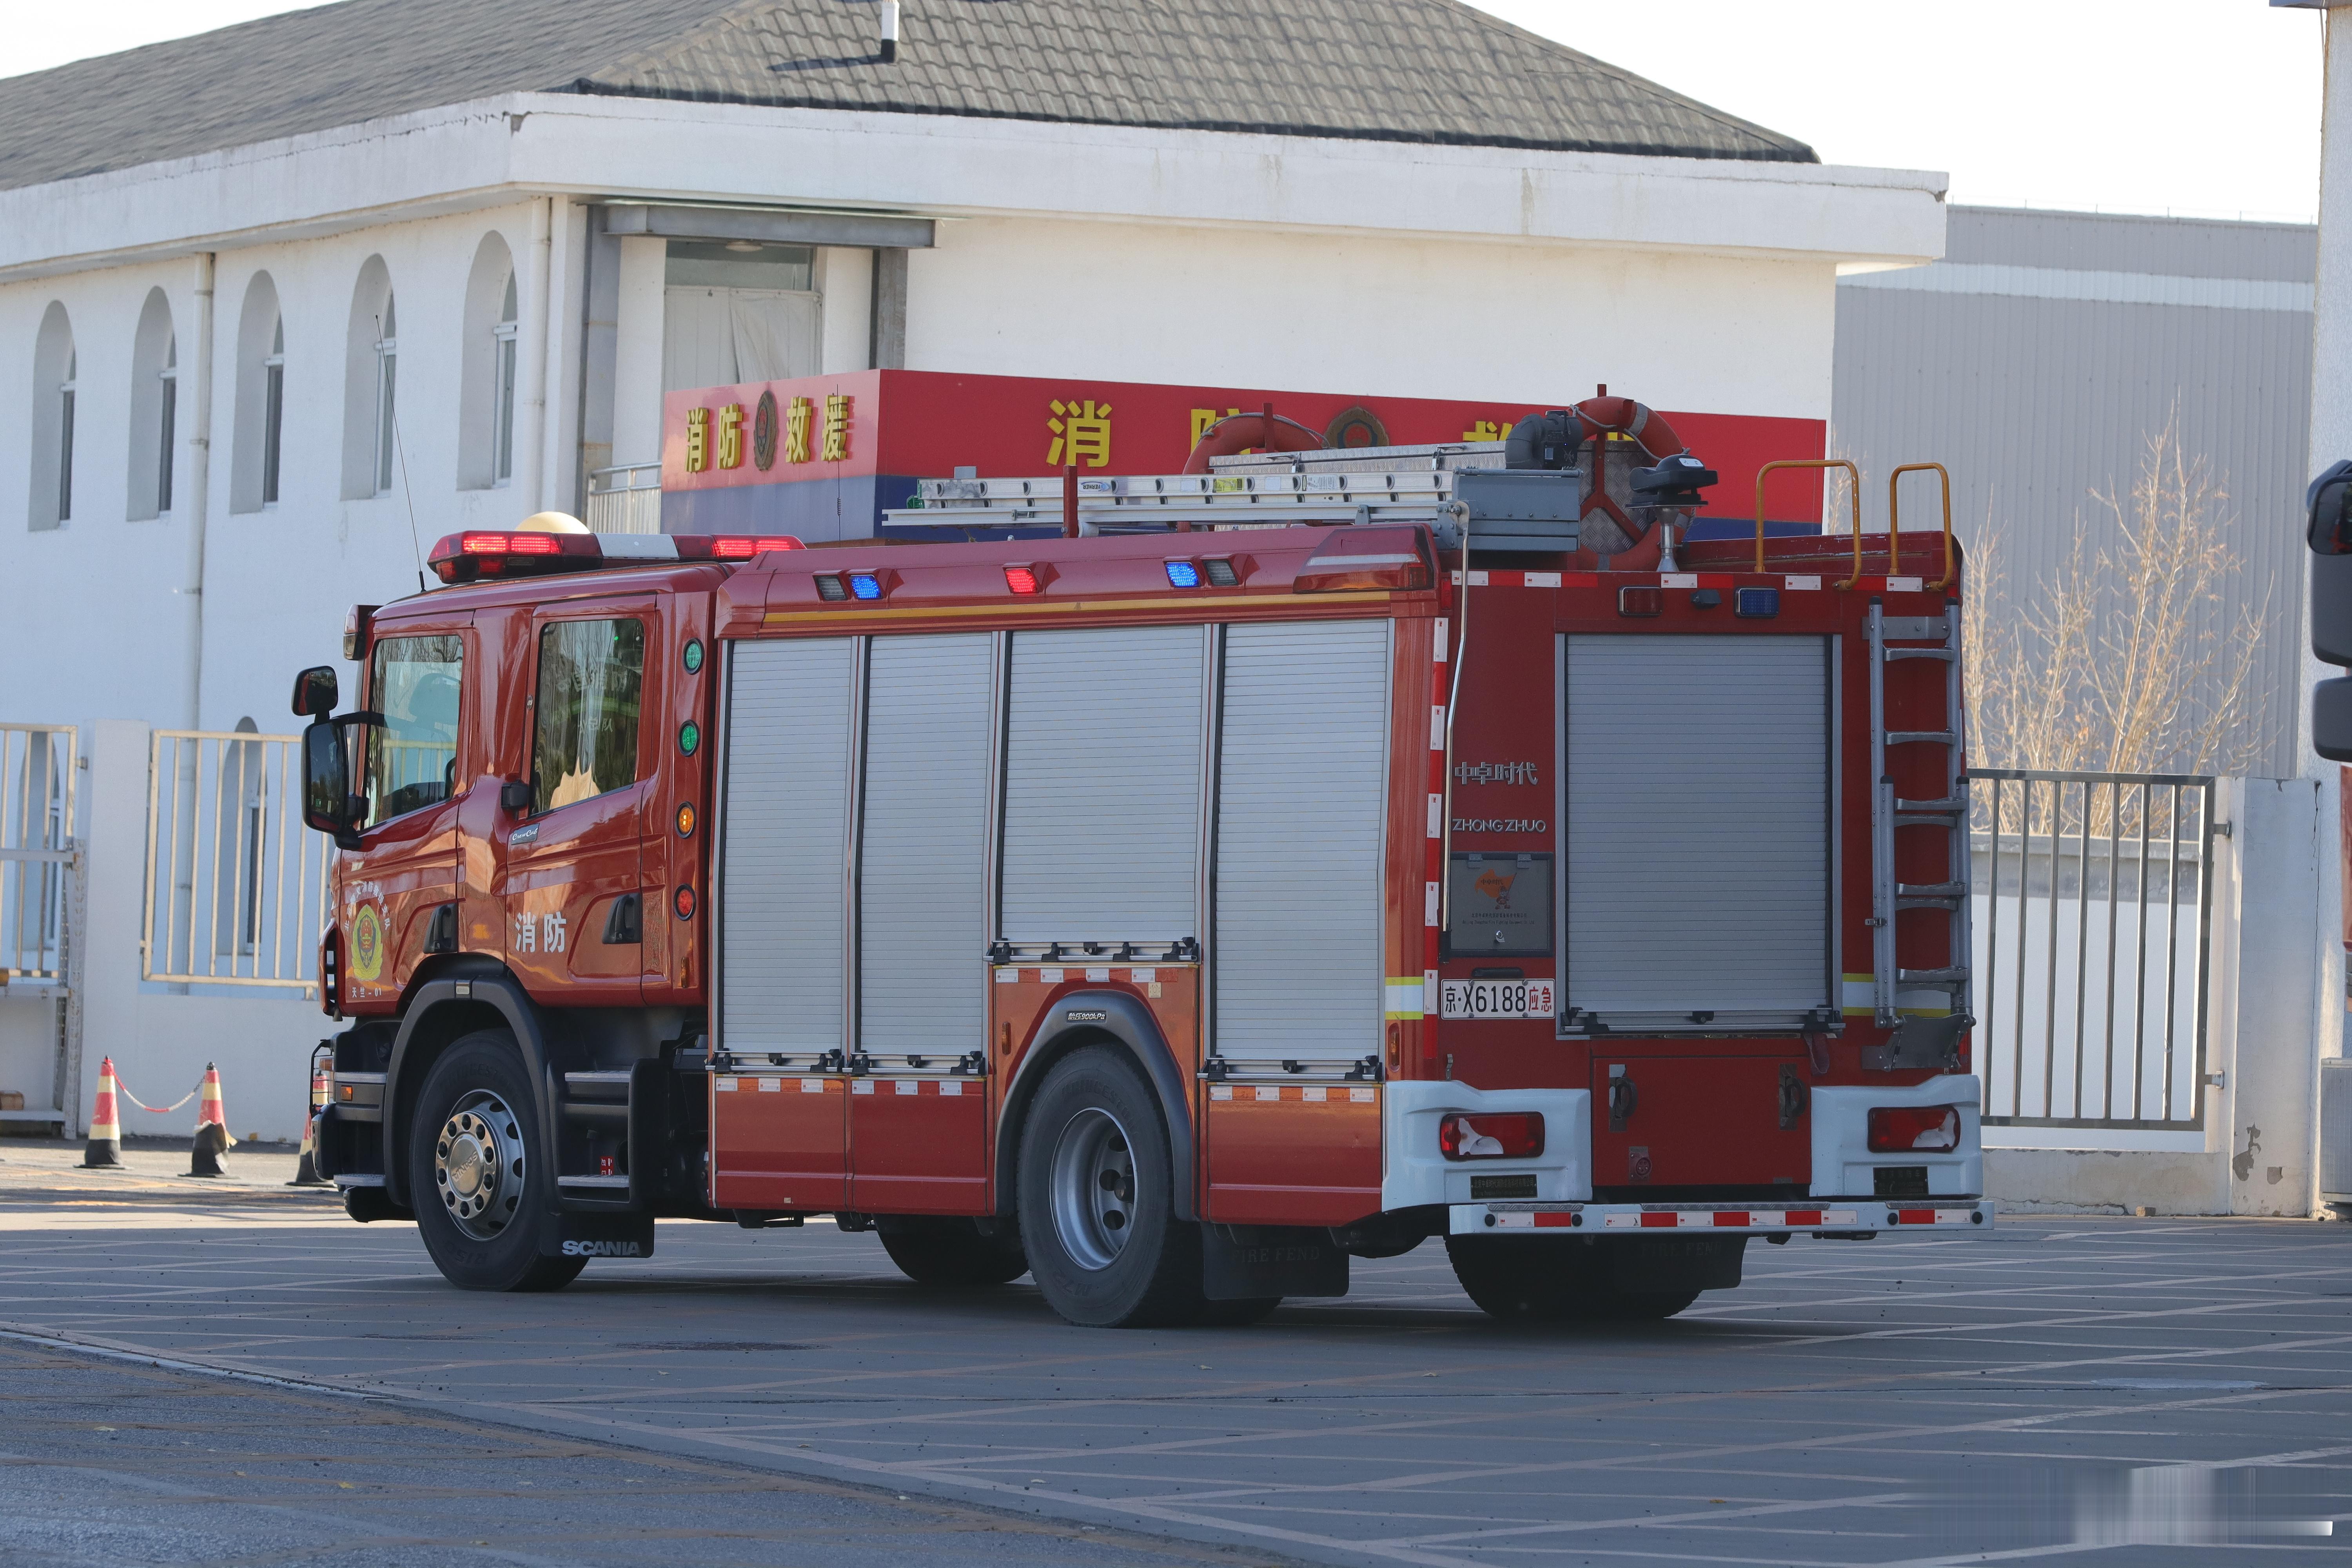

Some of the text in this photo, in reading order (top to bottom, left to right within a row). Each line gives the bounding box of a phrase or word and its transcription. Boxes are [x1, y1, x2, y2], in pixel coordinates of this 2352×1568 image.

[1455, 762, 1538, 785] 中卓时代
[515, 911, 567, 953] 消防
[452, 1151, 478, 1182] SCANIA
[562, 1240, 640, 1255] SCANIA
